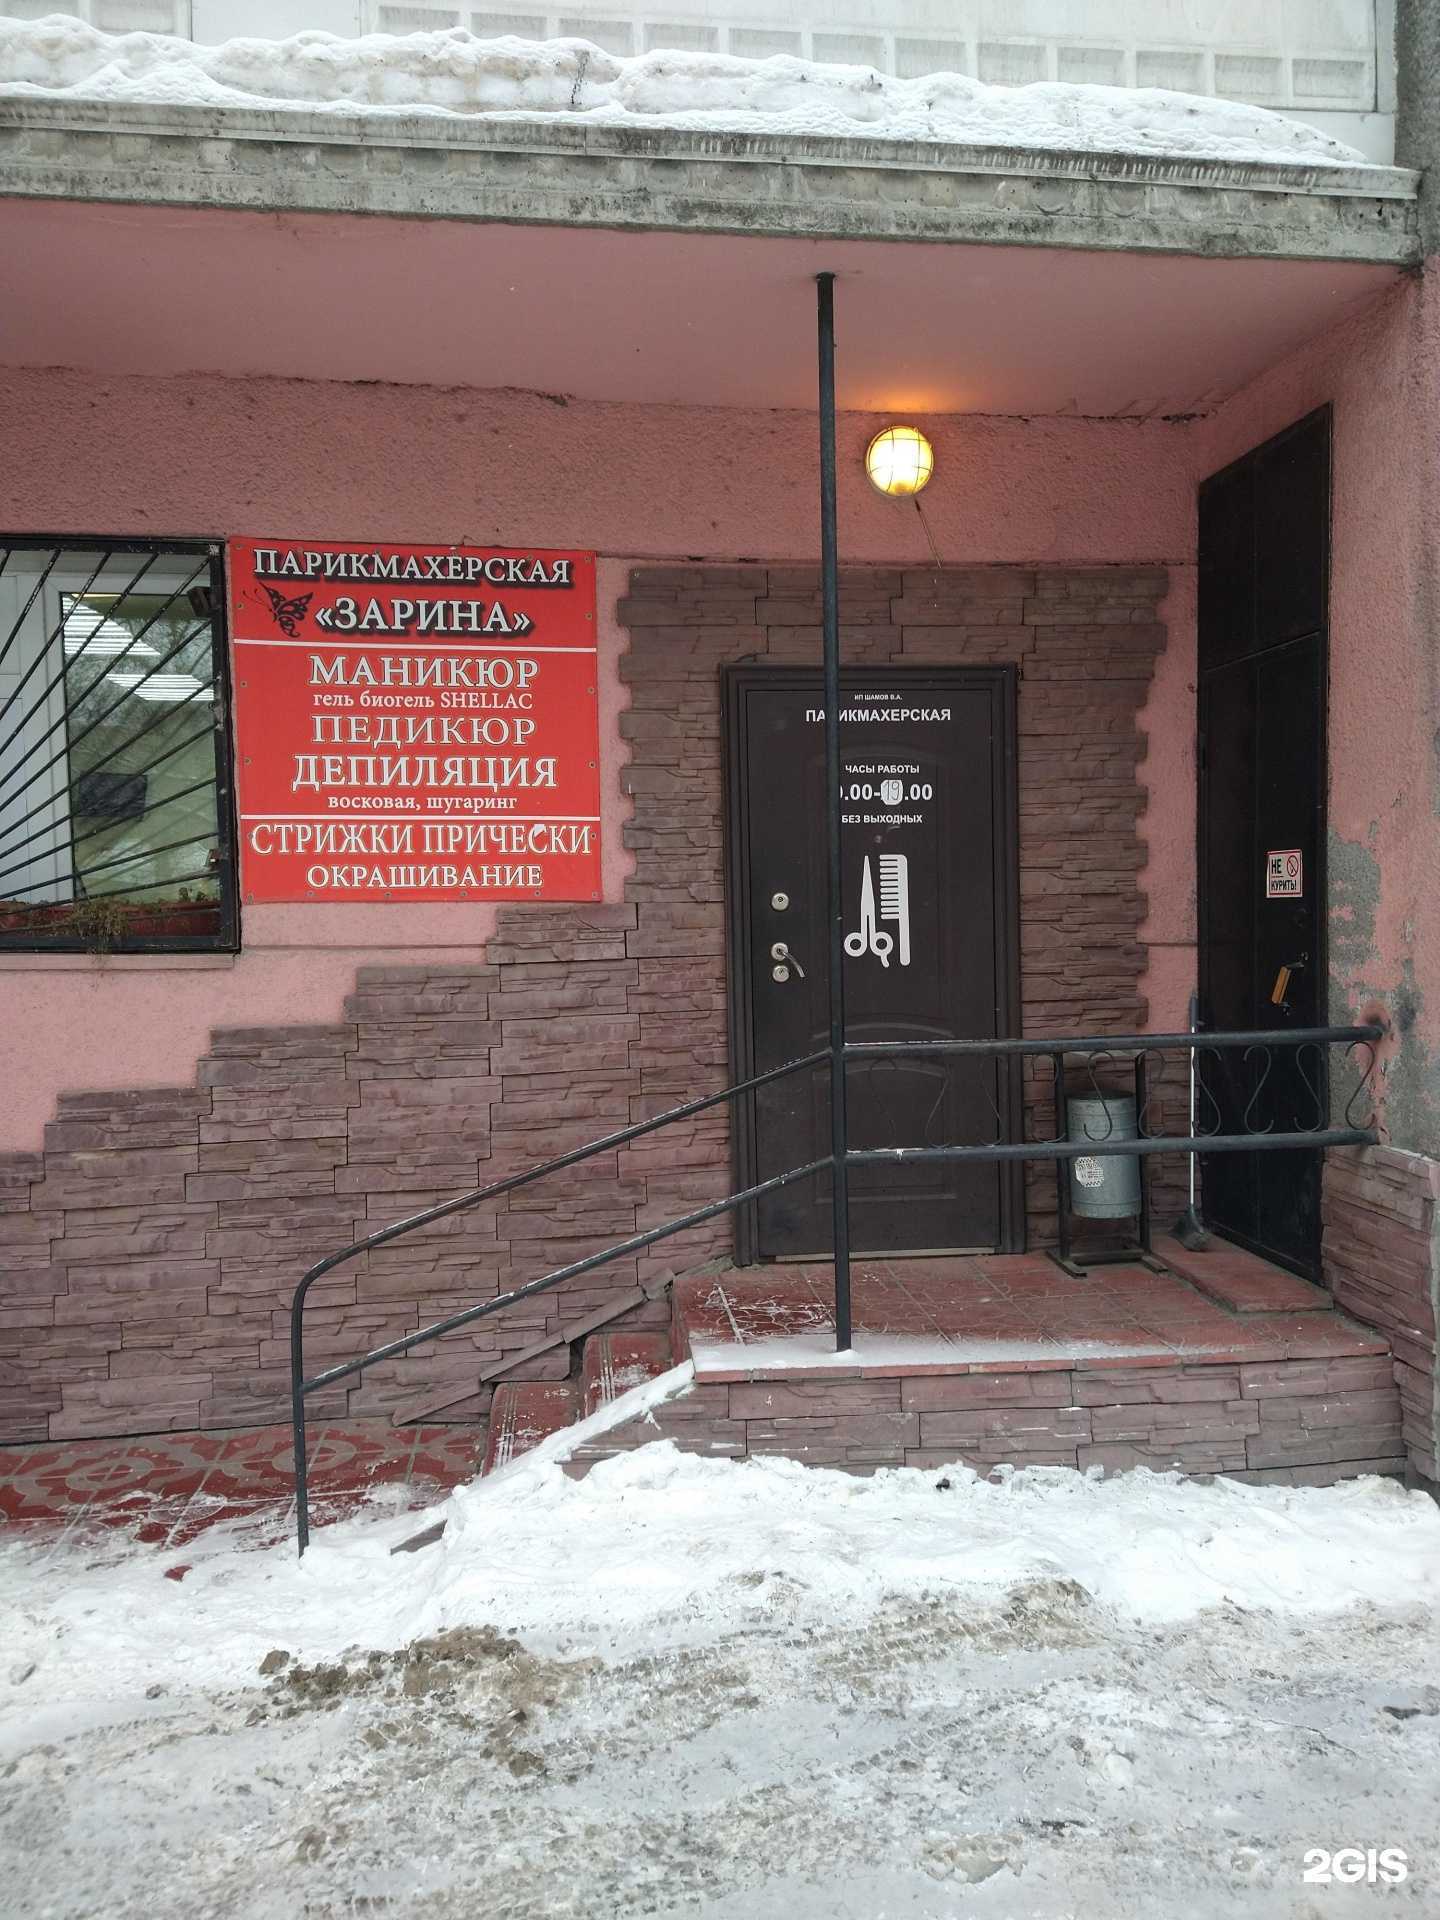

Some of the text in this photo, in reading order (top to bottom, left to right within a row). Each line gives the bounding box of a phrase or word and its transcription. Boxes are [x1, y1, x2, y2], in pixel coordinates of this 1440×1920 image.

[253, 549, 570, 583] ПАРИКМАХЕРСКАЯ
[314, 597, 532, 633] «ЗАРИНА»
[309, 655, 539, 688] МАНИКЮР
[313, 690, 533, 709] гель биогель SHELLAC
[806, 708, 951, 722] ПАИКМАХЕРСКАЯ
[311, 715, 536, 749] ПЕДИКЮР
[292, 754, 558, 792] ДЕПИЛЯЦИЯ
[845, 765, 920, 774] ЧАСЫ РАБОТЫ
[328, 796, 517, 813] восковая, шугаринг
[841, 814, 923, 824] БЕЗ ВЫХОДНЫХ
[251, 823, 591, 855] СТРИЖКИ ПРИЧЕСКИ
[306, 864, 543, 888] ОКРАШИВАНИЕ
[1271, 858, 1282, 874] НЕ
[1271, 880, 1297, 891] КУРИТЬ!
